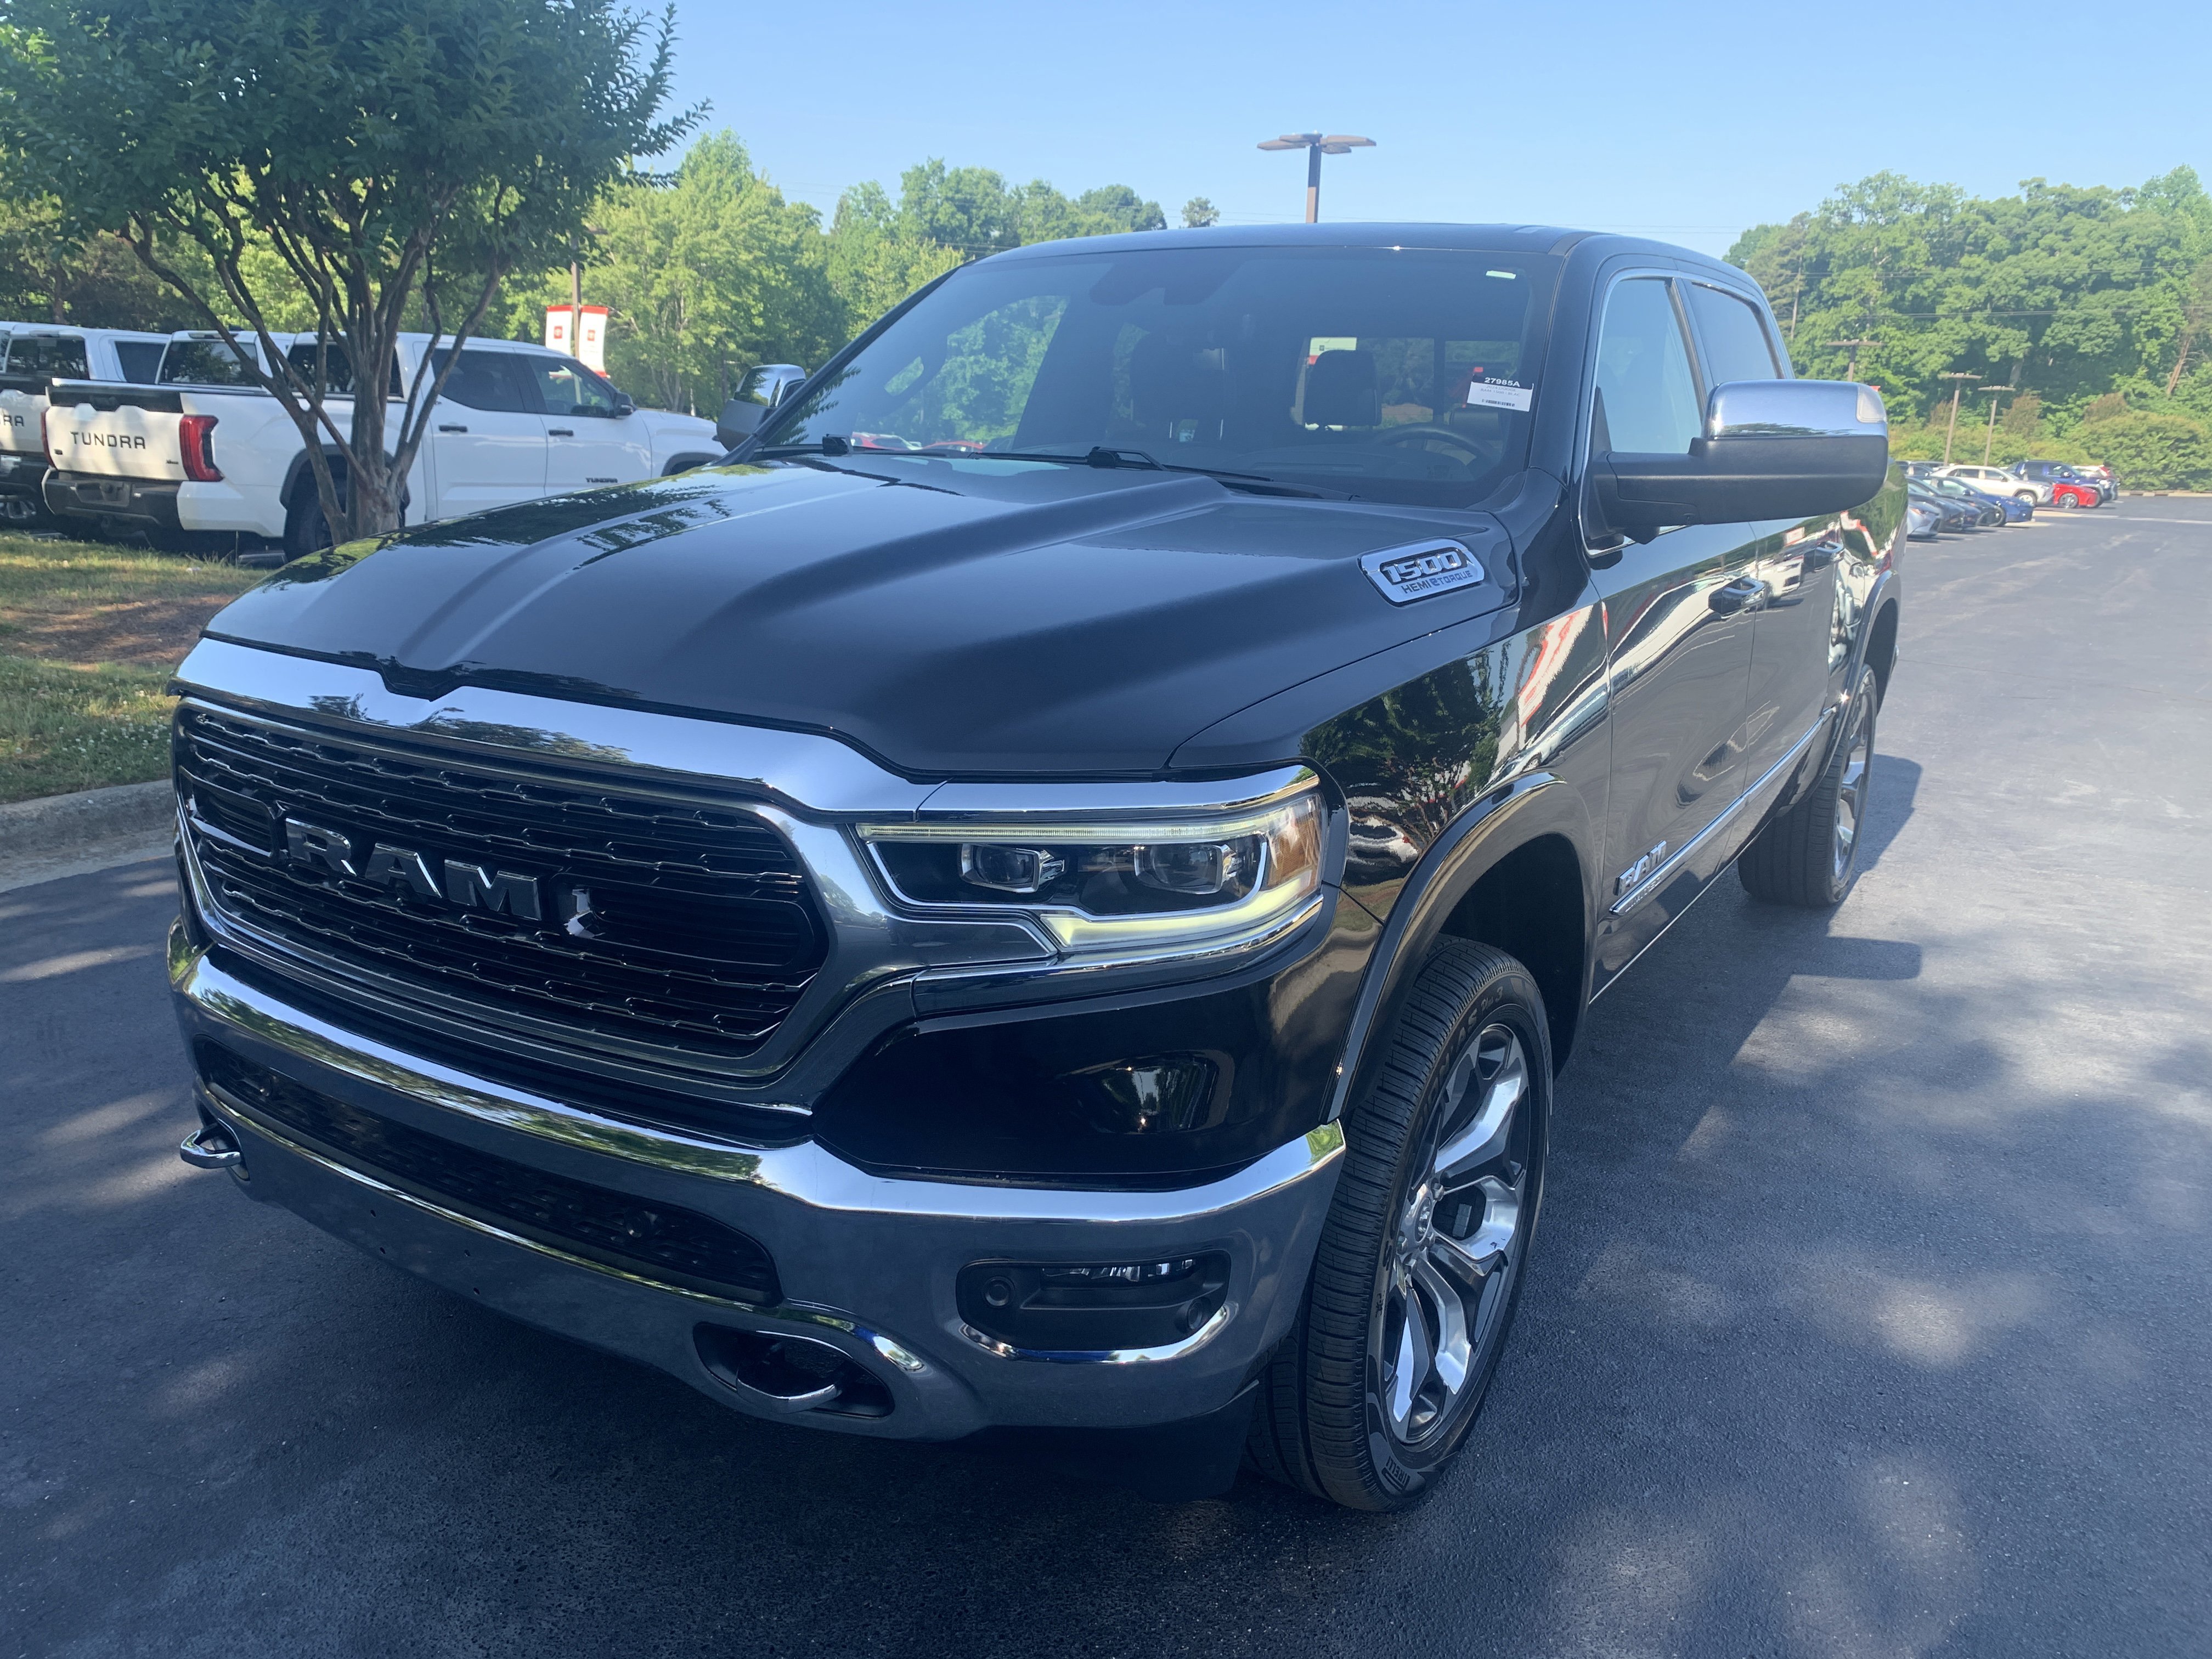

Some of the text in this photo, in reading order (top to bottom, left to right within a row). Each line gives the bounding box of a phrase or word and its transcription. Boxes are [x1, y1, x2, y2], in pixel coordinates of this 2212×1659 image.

[1484, 377, 1520, 387] 27985A
[70, 431, 146, 449] TUNDRA
[1381, 551, 1462, 583] 1500
[1401, 580, 1432, 594] HEMI
[285, 817, 542, 921] RAM
[1613, 840, 1667, 896] RAM
[1381, 1455, 1411, 1493] PIRELLI
